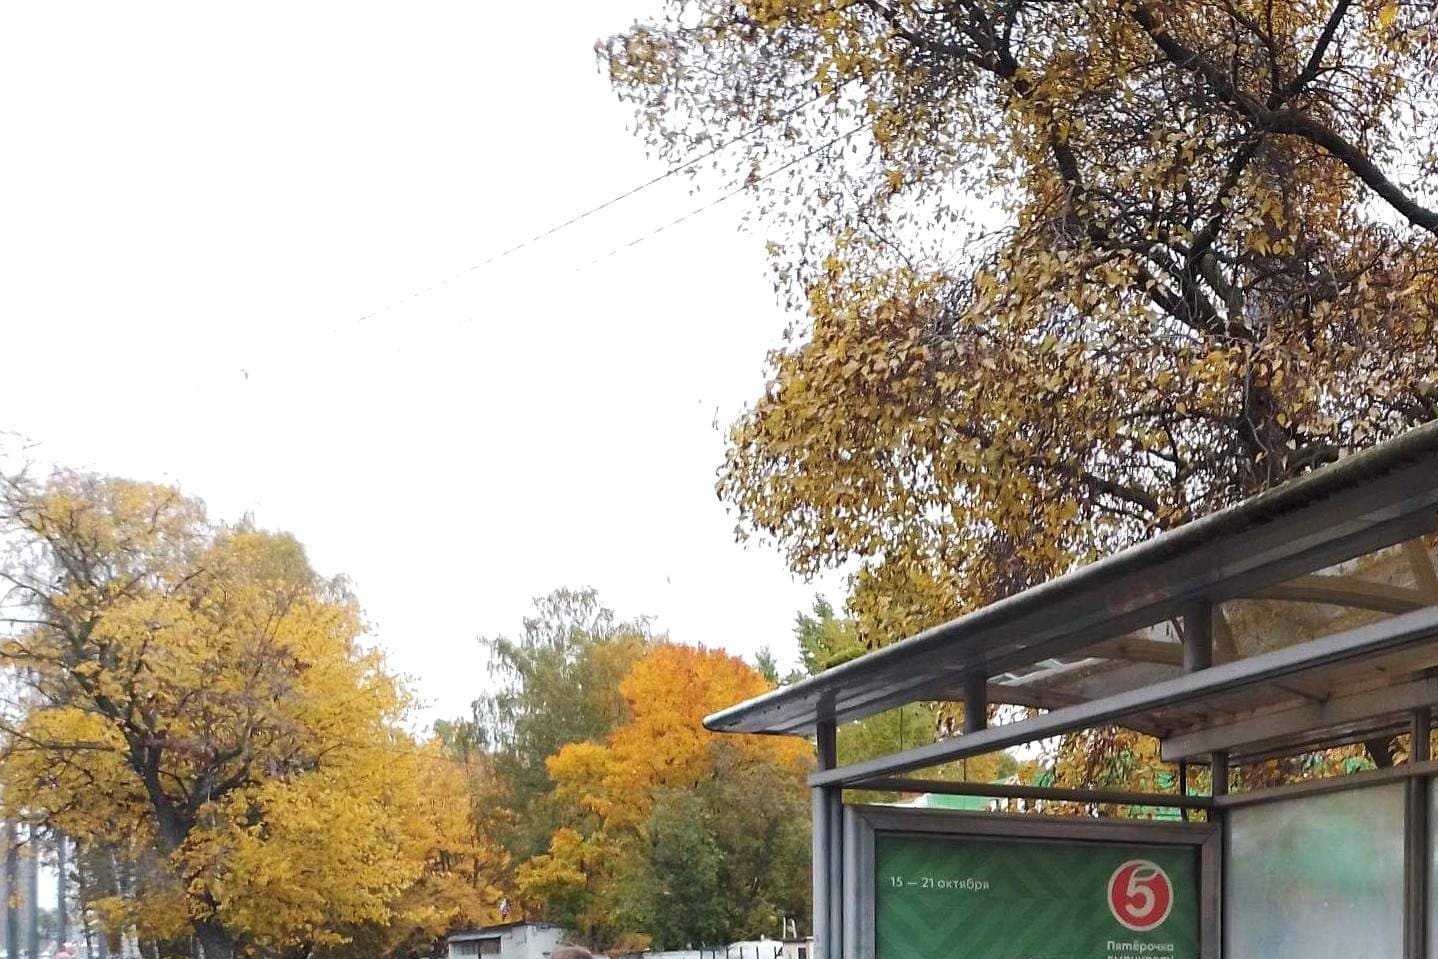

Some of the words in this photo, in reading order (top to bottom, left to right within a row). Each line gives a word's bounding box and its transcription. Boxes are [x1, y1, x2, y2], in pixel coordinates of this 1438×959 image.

[890, 876, 903, 888] 15
[921, 877, 934, 888] 21
[937, 878, 990, 892] октября
[1107, 940, 1174, 954] Пятёрочка
